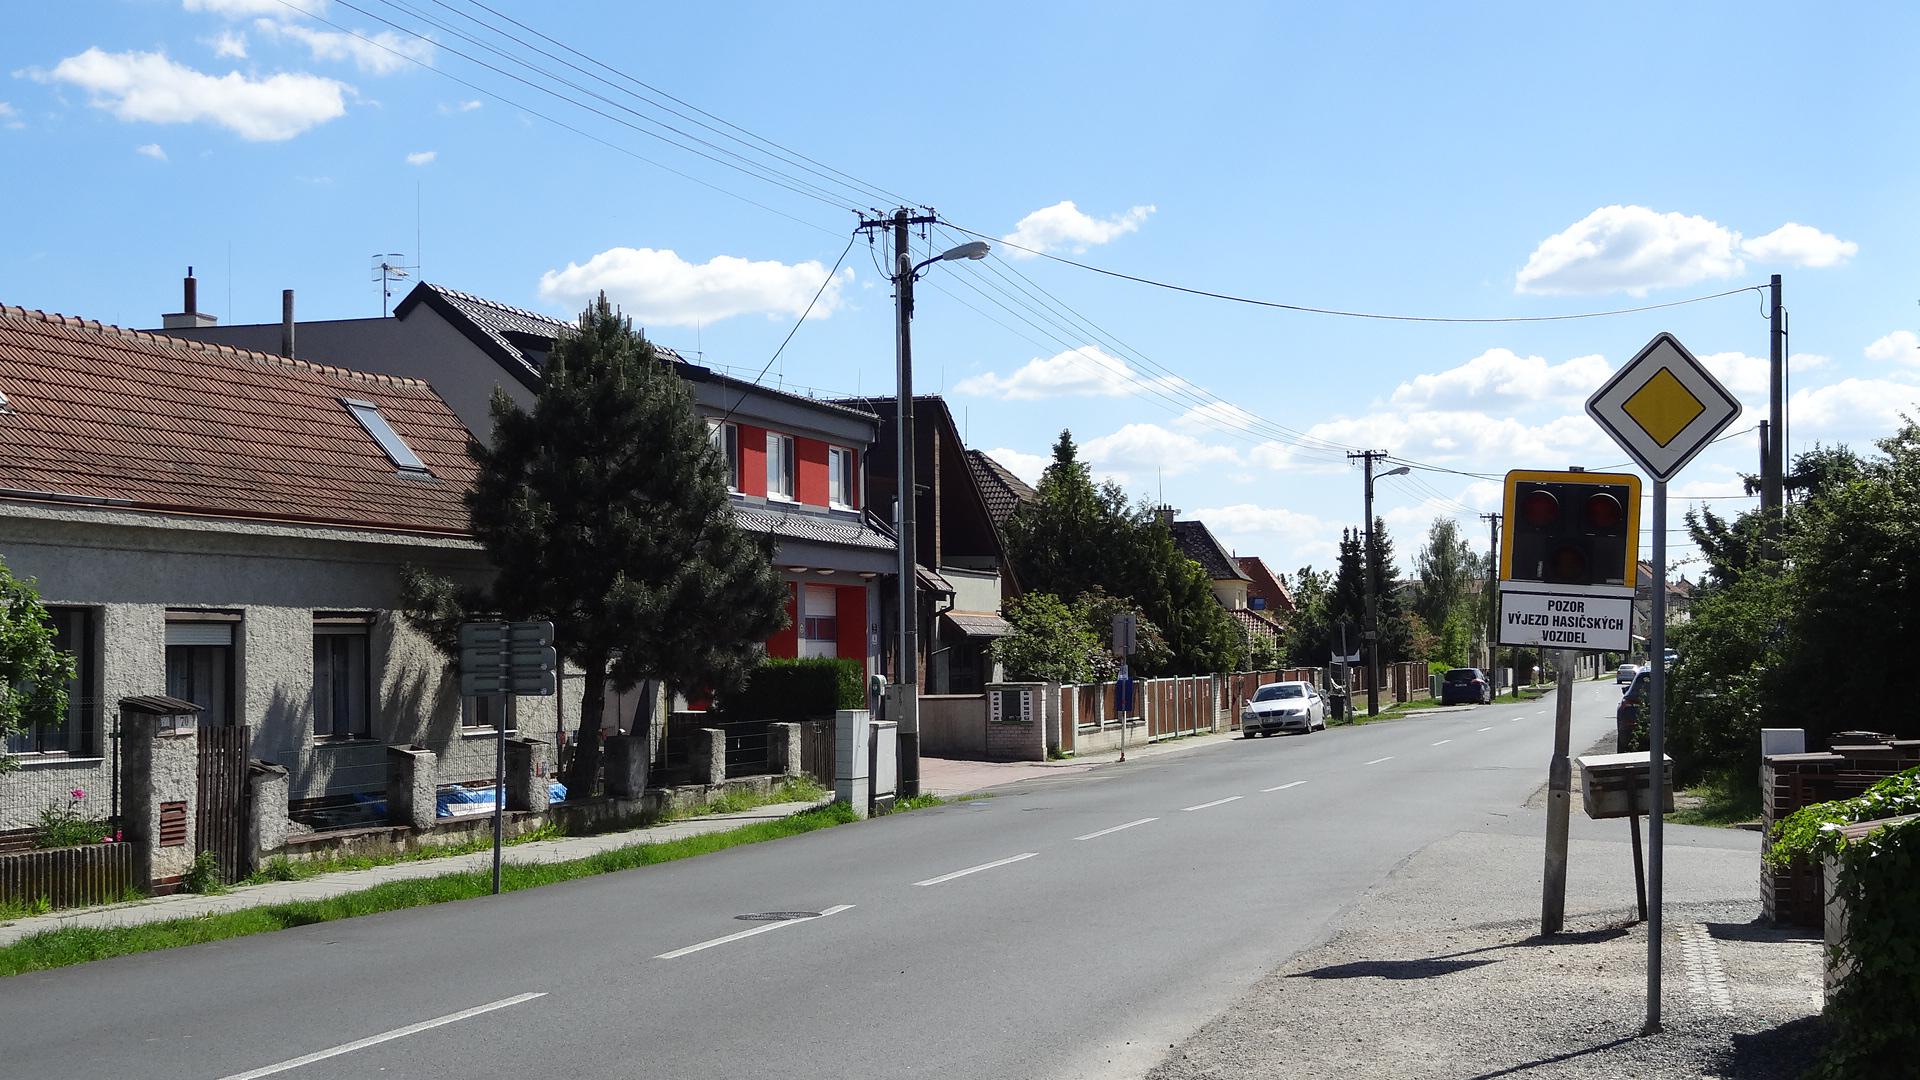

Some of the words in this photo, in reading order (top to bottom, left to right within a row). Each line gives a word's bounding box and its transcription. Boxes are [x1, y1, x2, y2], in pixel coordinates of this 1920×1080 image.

[1548, 600, 1585, 613] POZOR
[1508, 611, 1549, 626] VÝJEZD
[1552, 614, 1624, 630] HASIČSKÝCH
[1542, 630, 1587, 644] VOZIDEL
